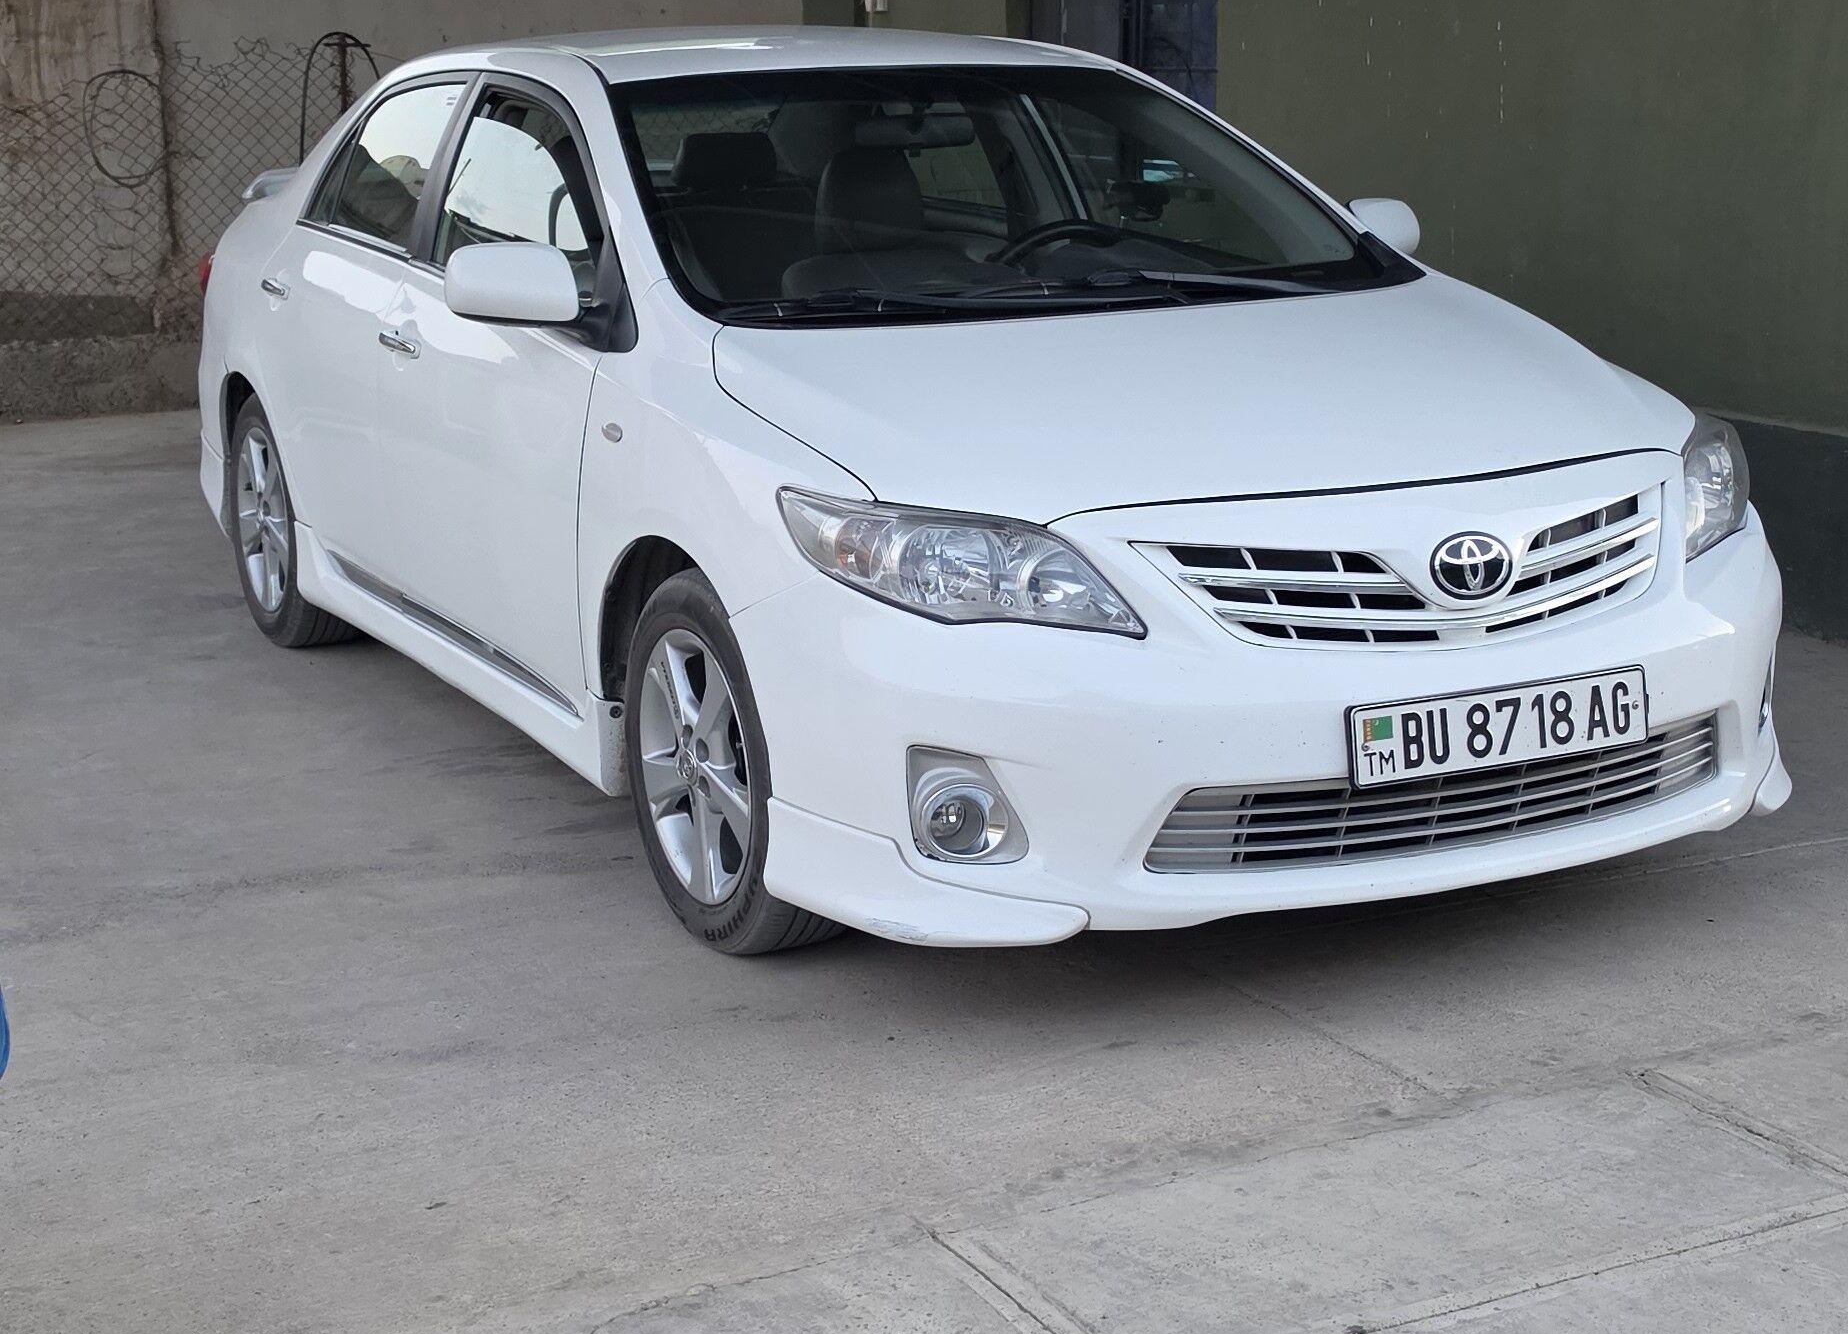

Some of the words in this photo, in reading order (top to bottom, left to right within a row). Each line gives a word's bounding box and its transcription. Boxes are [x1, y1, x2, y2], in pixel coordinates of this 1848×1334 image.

[1401, 707, 1450, 770] BU
[1466, 690, 1575, 759] 8718
[1587, 681, 1631, 741] AG
[1364, 749, 1396, 777] TM
